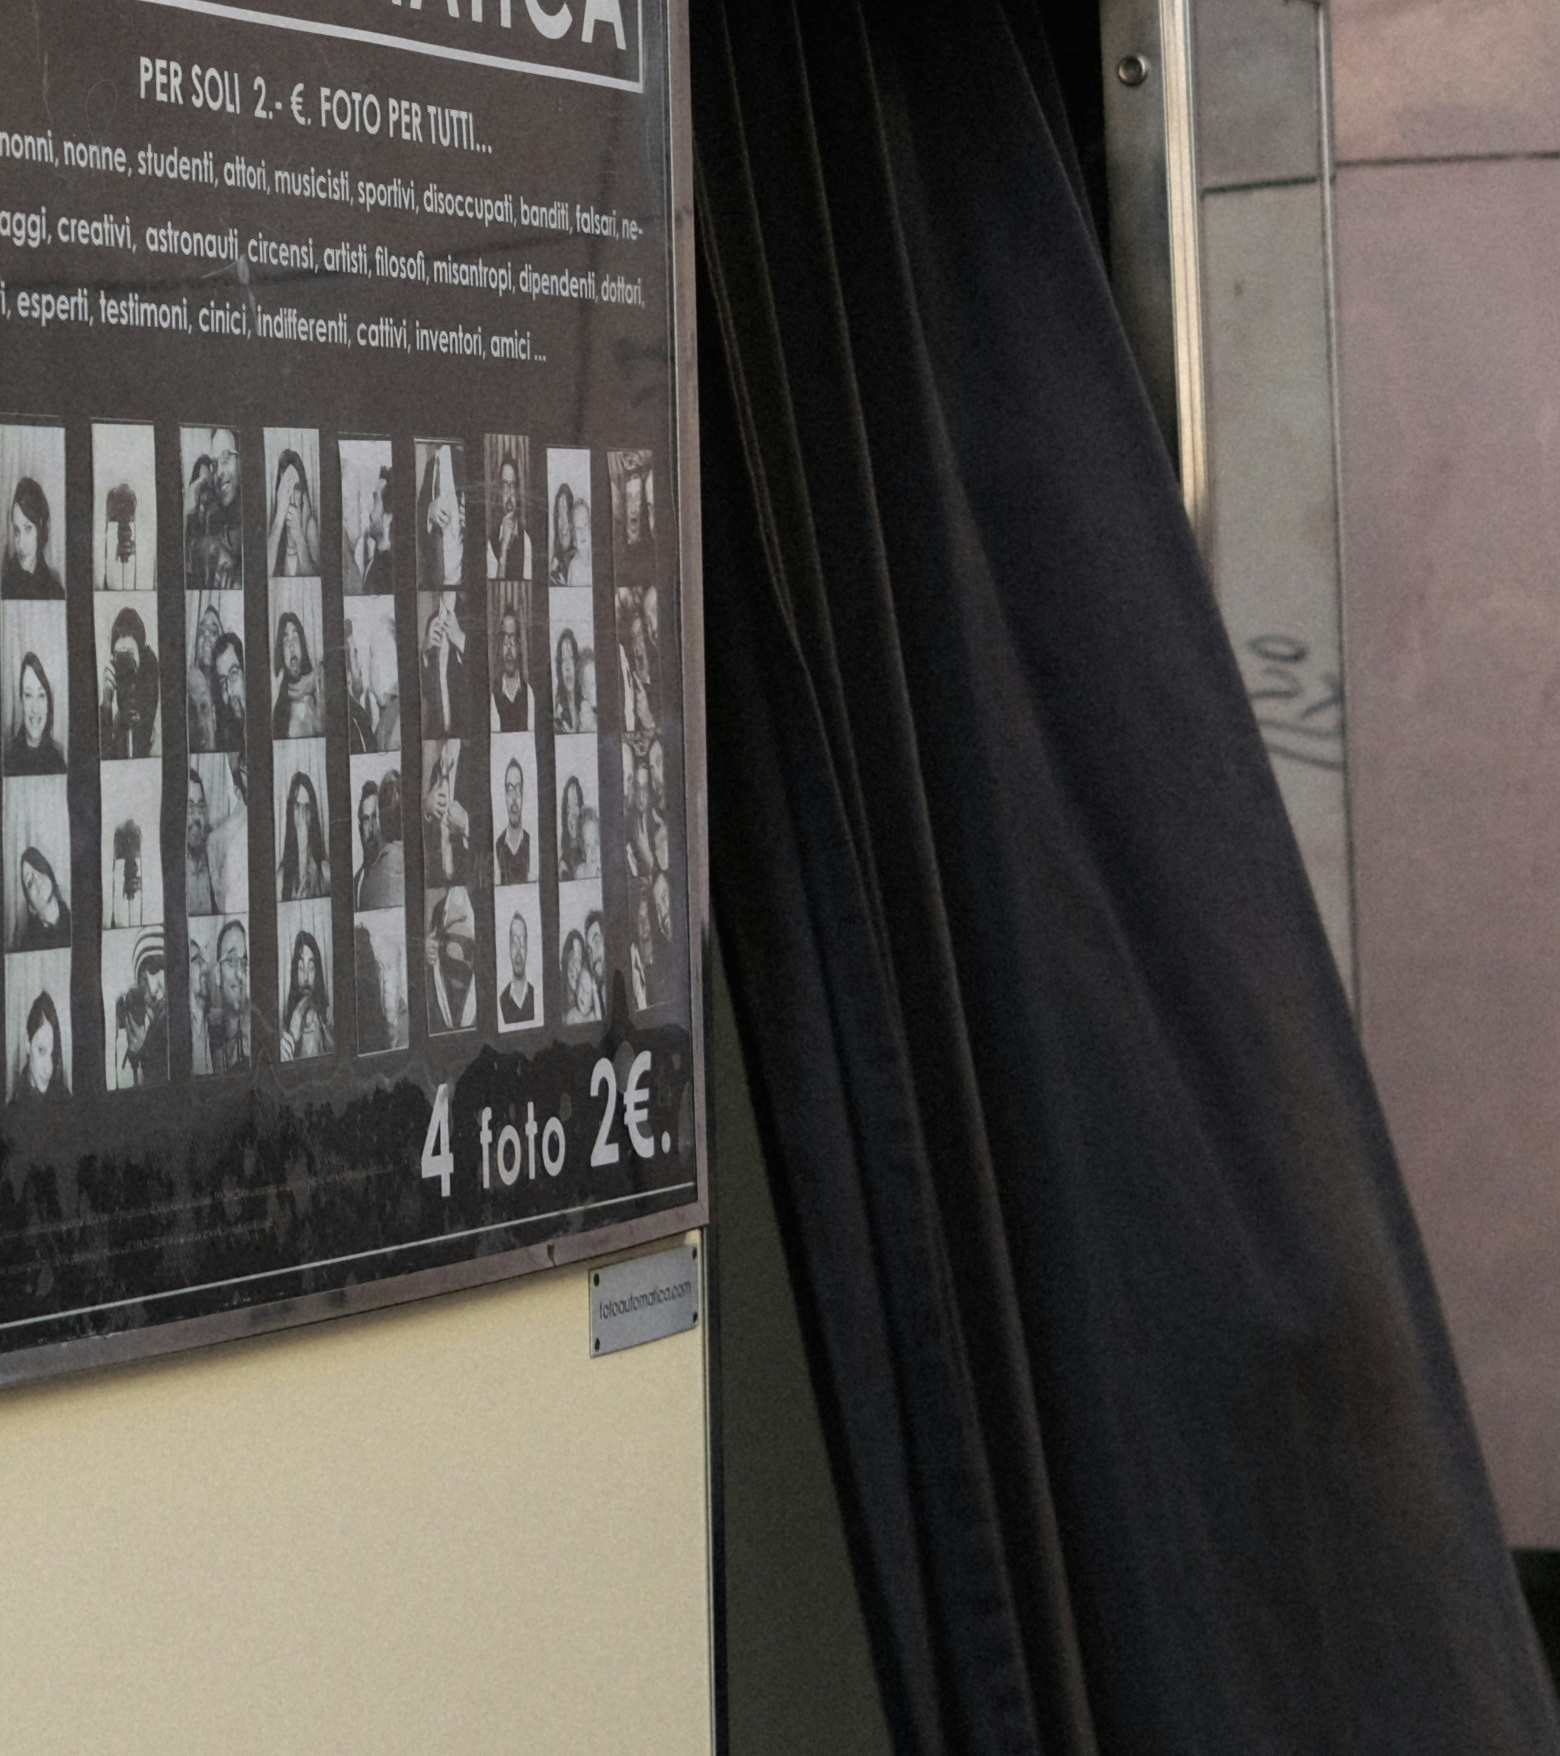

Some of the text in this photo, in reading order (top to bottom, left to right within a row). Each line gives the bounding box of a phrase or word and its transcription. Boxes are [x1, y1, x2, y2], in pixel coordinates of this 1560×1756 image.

[139, 55, 184, 105] PER
[190, 63, 241, 116] SOLI
[319, 86, 380, 135] FOTO
[388, 96, 424, 143] PER
[426, 103, 494, 155] TUTTI...
[63, 140, 133, 178] nonne,
[137, 143, 220, 188] studenti,
[223, 154, 271, 195] attori,
[274, 166, 355, 206] musicisti,
[357, 177, 420, 215] sportivi,
[422, 184, 518, 229] disoccupati,
[519, 196, 574, 235] banditi,
[575, 203, 620, 241] falsari,
[621, 217, 644, 241] ne-
[57, 213, 137, 254] creativi,
[247, 232, 320, 274] circensi,
[323, 242, 373, 281] artisti,
[375, 246, 430, 286] filosofi,
[433, 256, 516, 295] misantropi,
[519, 264, 599, 304] dipendenti,
[600, 274, 646, 309] dottori,
[17, 289, 95, 327] esperti,
[99, 290, 194, 335] testimoni,
[198, 300, 252, 341] cinici,
[257, 305, 353, 349] indifferenti,
[356, 314, 412, 354] cattivi,
[415, 319, 487, 360] inventori,
[489, 330, 531, 361] amici
[420, 1083, 455, 1198] 4
[479, 1099, 568, 1189] foto
[599, 1280, 693, 1320] fotoautomatica.com
